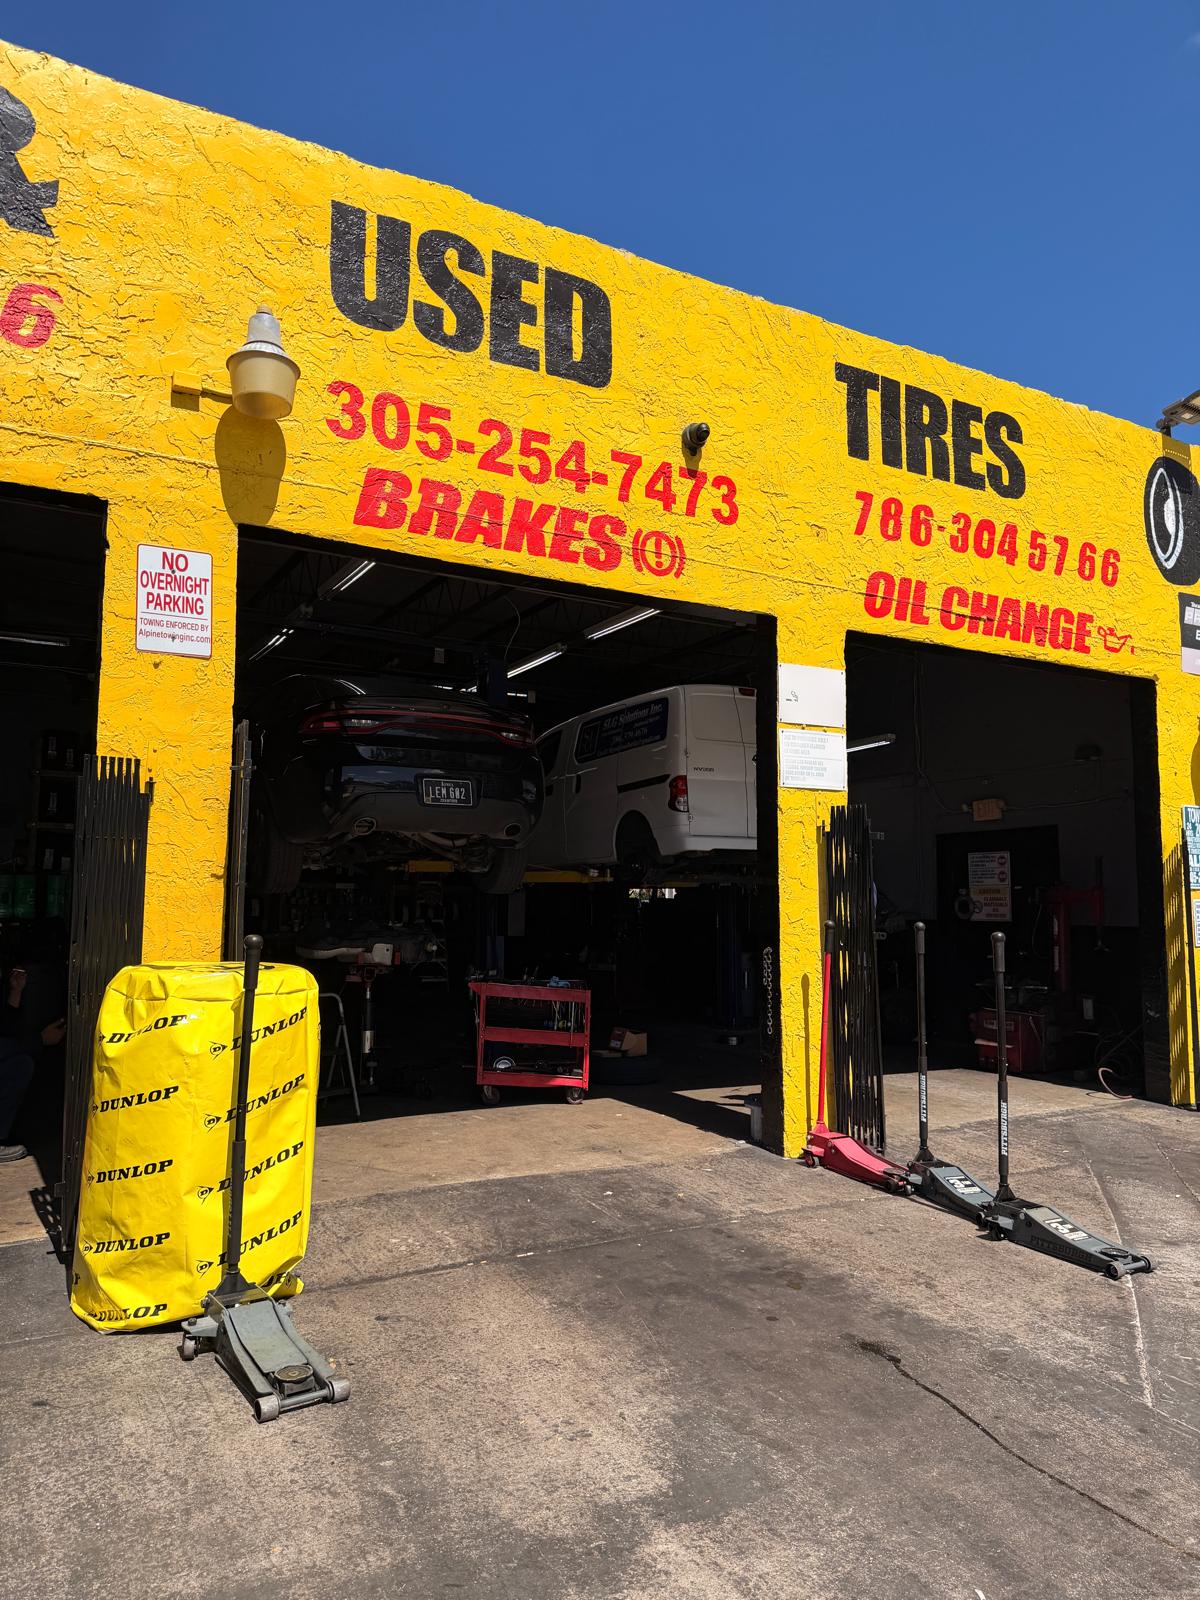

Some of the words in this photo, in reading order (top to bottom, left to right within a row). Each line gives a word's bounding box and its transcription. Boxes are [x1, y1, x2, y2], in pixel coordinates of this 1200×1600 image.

[329, 199, 612, 388] USED
[835, 361, 1026, 499] TIRES
[325, 380, 739, 525] 305-254-7473
[353, 467, 627, 572] BRAKES
[161, 551, 189, 572] NO
[140, 570, 209, 595] OVERNIGHT
[146, 591, 204, 615] PARKING
[863, 571, 930, 626] OIL
[939, 586, 1095, 655] CHANGE
[140, 617, 164, 628] TOWING
[165, 620, 199, 631] ENFORCED
[200, 624, 209, 632] BY
[100, 1085, 179, 1113] DUNLOP
[96, 1159, 174, 1183] DUNLOP
[93, 1232, 171, 1254] DUNLOP
